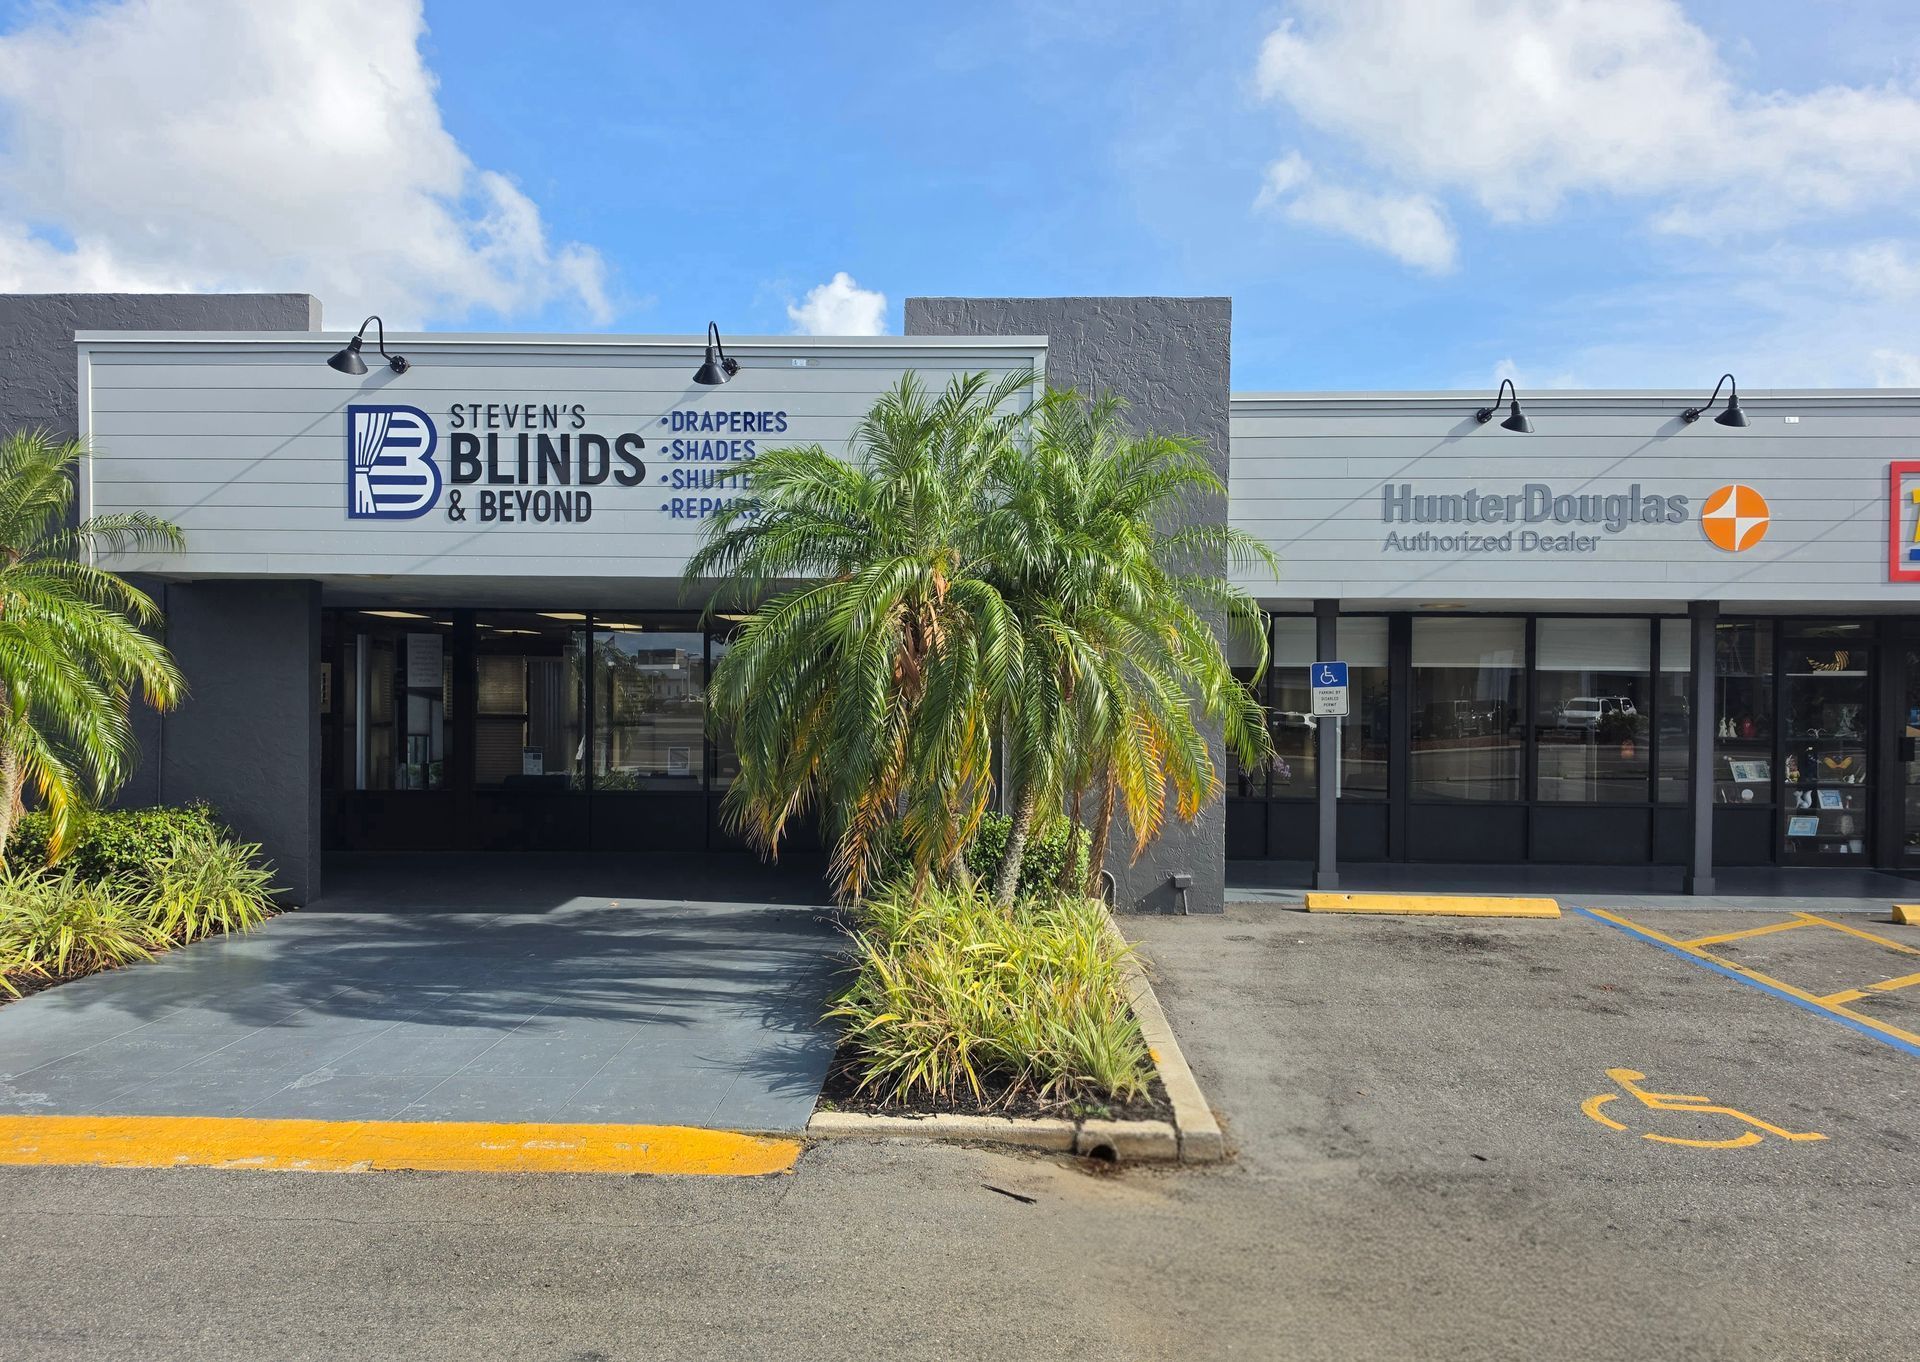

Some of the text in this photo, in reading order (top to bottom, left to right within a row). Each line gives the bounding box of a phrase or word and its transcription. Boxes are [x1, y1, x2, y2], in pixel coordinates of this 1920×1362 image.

[450, 404, 586, 429] STEVEN'S
[450, 433, 647, 486] BLINDS
[448, 489, 593, 522] & BEYOND
[1384, 483, 1690, 533] HunterDouglas
[1384, 531, 1600, 552] Authorized Dealer
